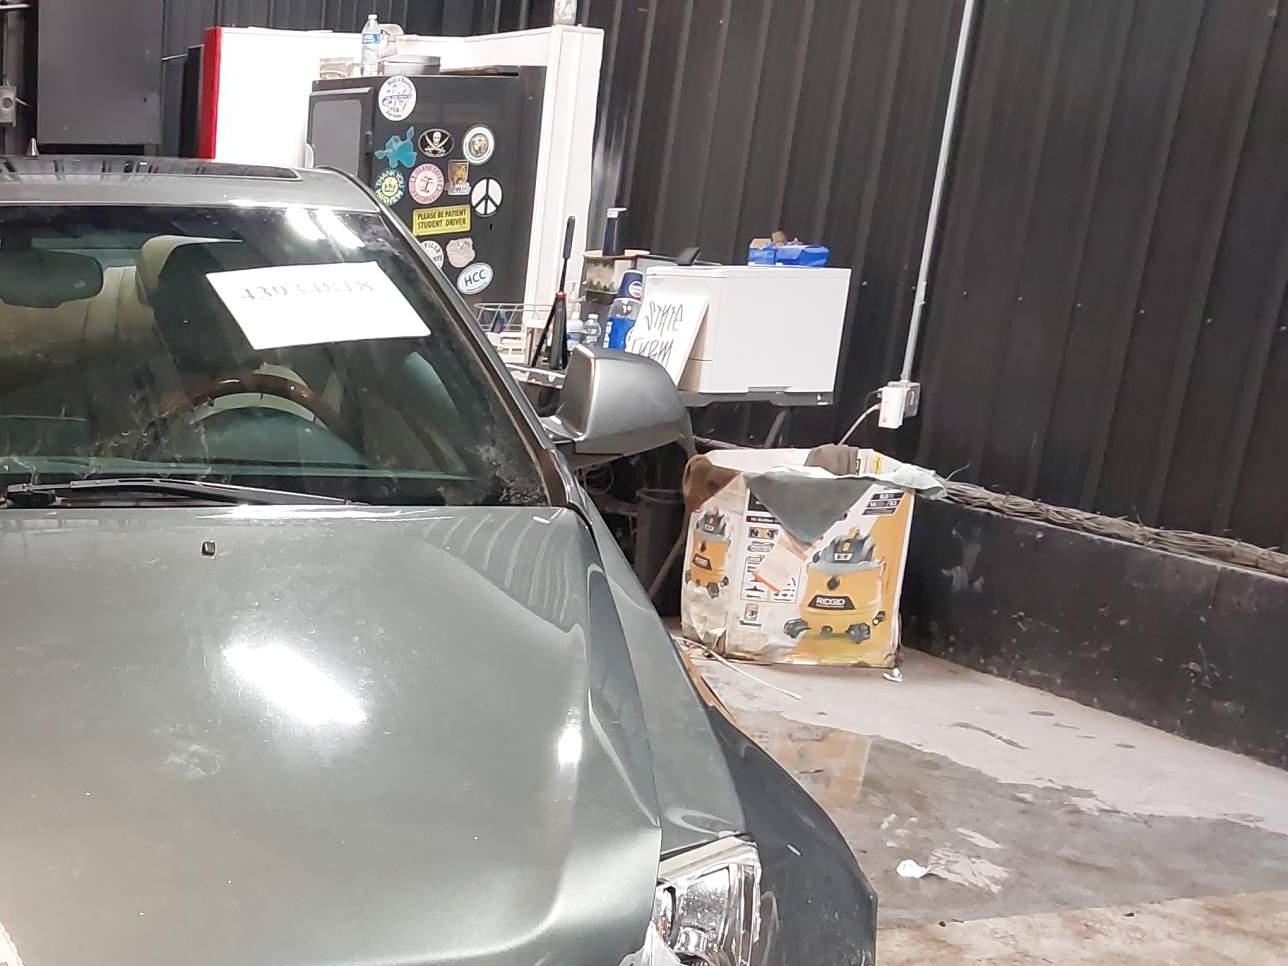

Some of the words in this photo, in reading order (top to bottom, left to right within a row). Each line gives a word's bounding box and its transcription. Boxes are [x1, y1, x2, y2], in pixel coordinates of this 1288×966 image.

[417, 211, 437, 220] PLEASE
[445, 208, 467, 218] PATIENT
[417, 219, 443, 230] STUDENT
[445, 217, 466, 227] DRIVER
[464, 269, 487, 287] HCC
[816, 596, 846, 606] RIDGID
